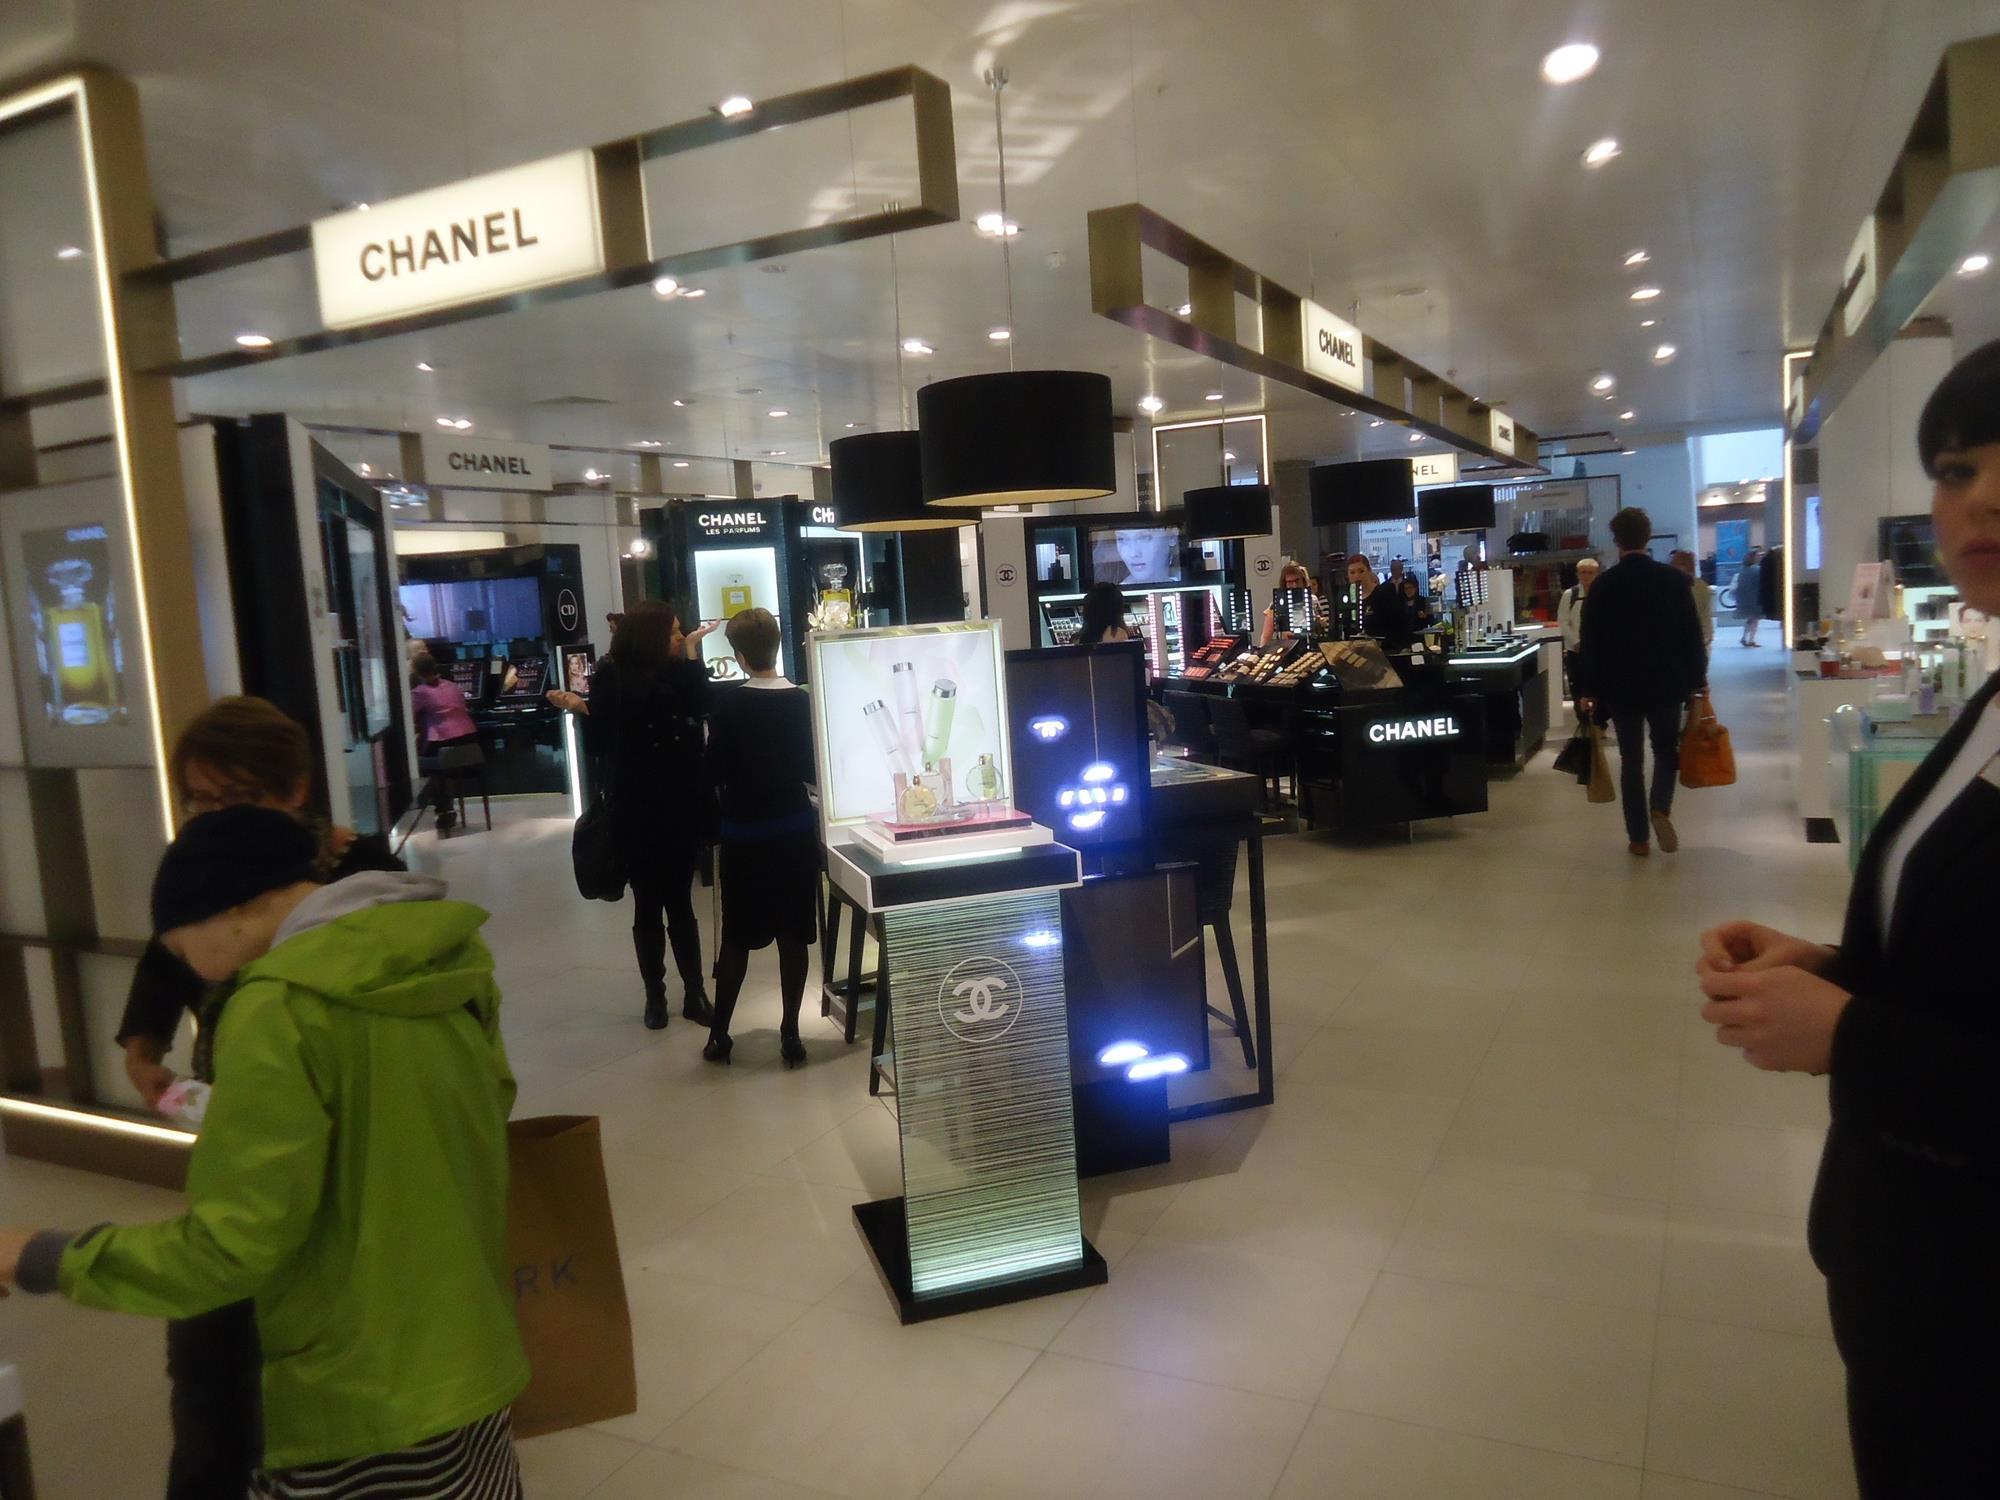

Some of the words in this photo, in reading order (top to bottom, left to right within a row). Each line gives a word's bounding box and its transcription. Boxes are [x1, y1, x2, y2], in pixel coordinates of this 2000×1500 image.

[360, 207, 539, 282] CHANEL
[1319, 328, 1356, 367] CHANEL
[448, 451, 532, 475] CHANEL
[1410, 465, 1439, 476] NEL
[698, 512, 767, 527] CHANEL
[723, 526, 761, 535] PARFUMS
[560, 604, 575, 616] CD
[1369, 717, 1459, 742] CHANEL
[513, 1248, 581, 1298] RK
